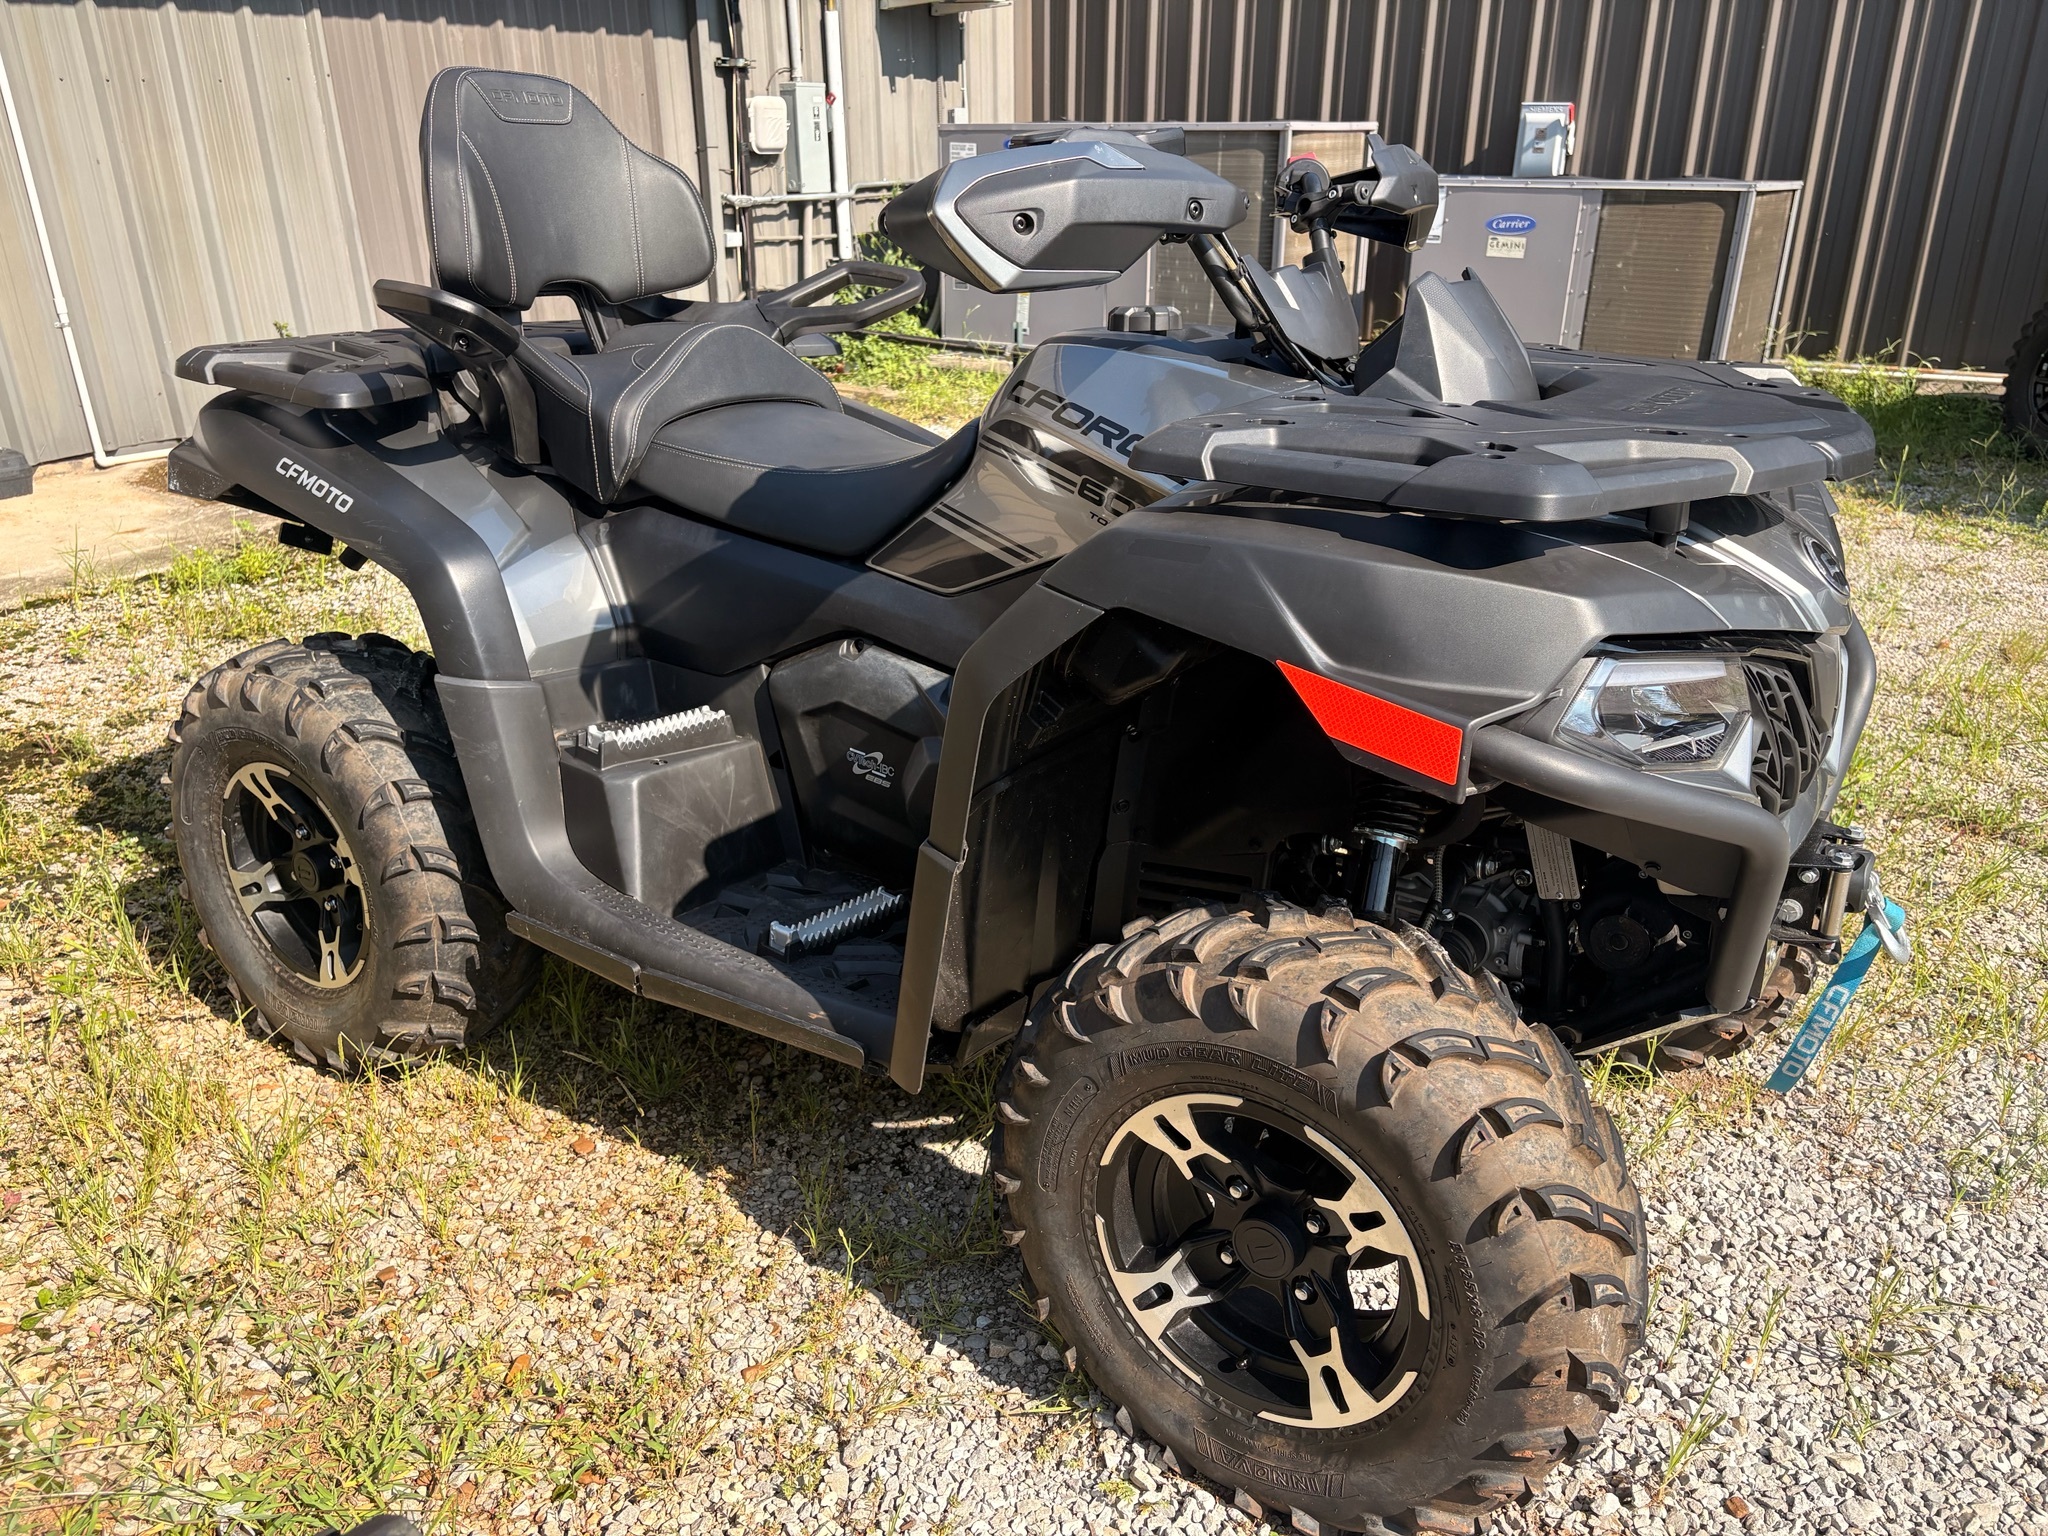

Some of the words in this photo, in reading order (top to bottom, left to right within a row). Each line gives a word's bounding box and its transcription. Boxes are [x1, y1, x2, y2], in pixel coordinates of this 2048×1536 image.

[1489, 241, 1525, 250] GEMINI
[1492, 218, 1531, 229] Carrier
[1007, 380, 1188, 486] CFORC
[275, 456, 354, 514] CFMOTO
[1781, 984, 1850, 1079] CFMOTO
[1128, 1047, 1170, 1066] MUD
[1178, 1046, 1242, 1066] GEAR
[1251, 1056, 1315, 1092] LITE
[1219, 1446, 1321, 1493] INNOVA
